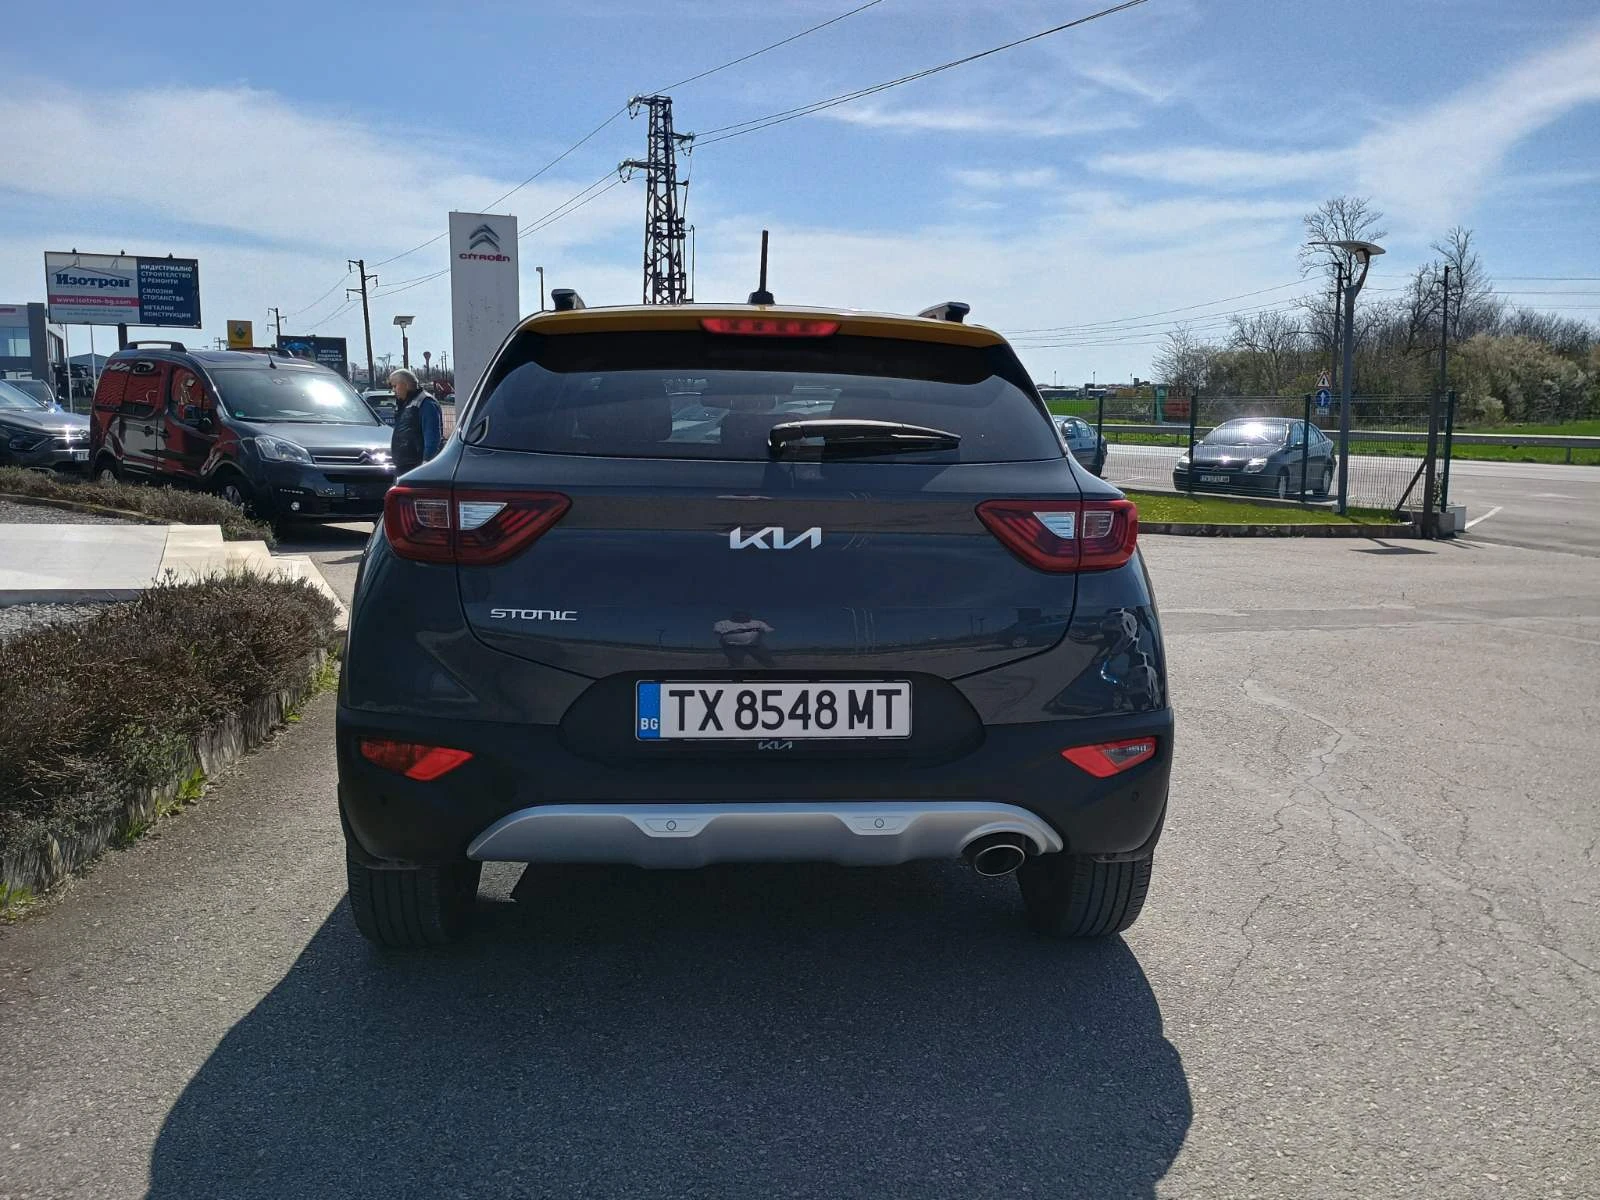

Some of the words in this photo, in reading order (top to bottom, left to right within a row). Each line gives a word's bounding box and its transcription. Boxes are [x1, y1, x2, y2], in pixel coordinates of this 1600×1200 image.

[459, 253, 510, 262] CITROËN
[140, 264, 192, 272] ИНДУСТРИАЛНО
[56, 274, 130, 288] Изотрон
[141, 271, 191, 279] СТРОИТЕЛСТВО
[729, 526, 822, 550] KIA
[490, 608, 578, 621] STONIC
[668, 689, 725, 731] TX
[734, 689, 839, 730] 8548
[847, 688, 902, 730] MT
[640, 717, 659, 730] BG
[757, 740, 794, 750] KIA
